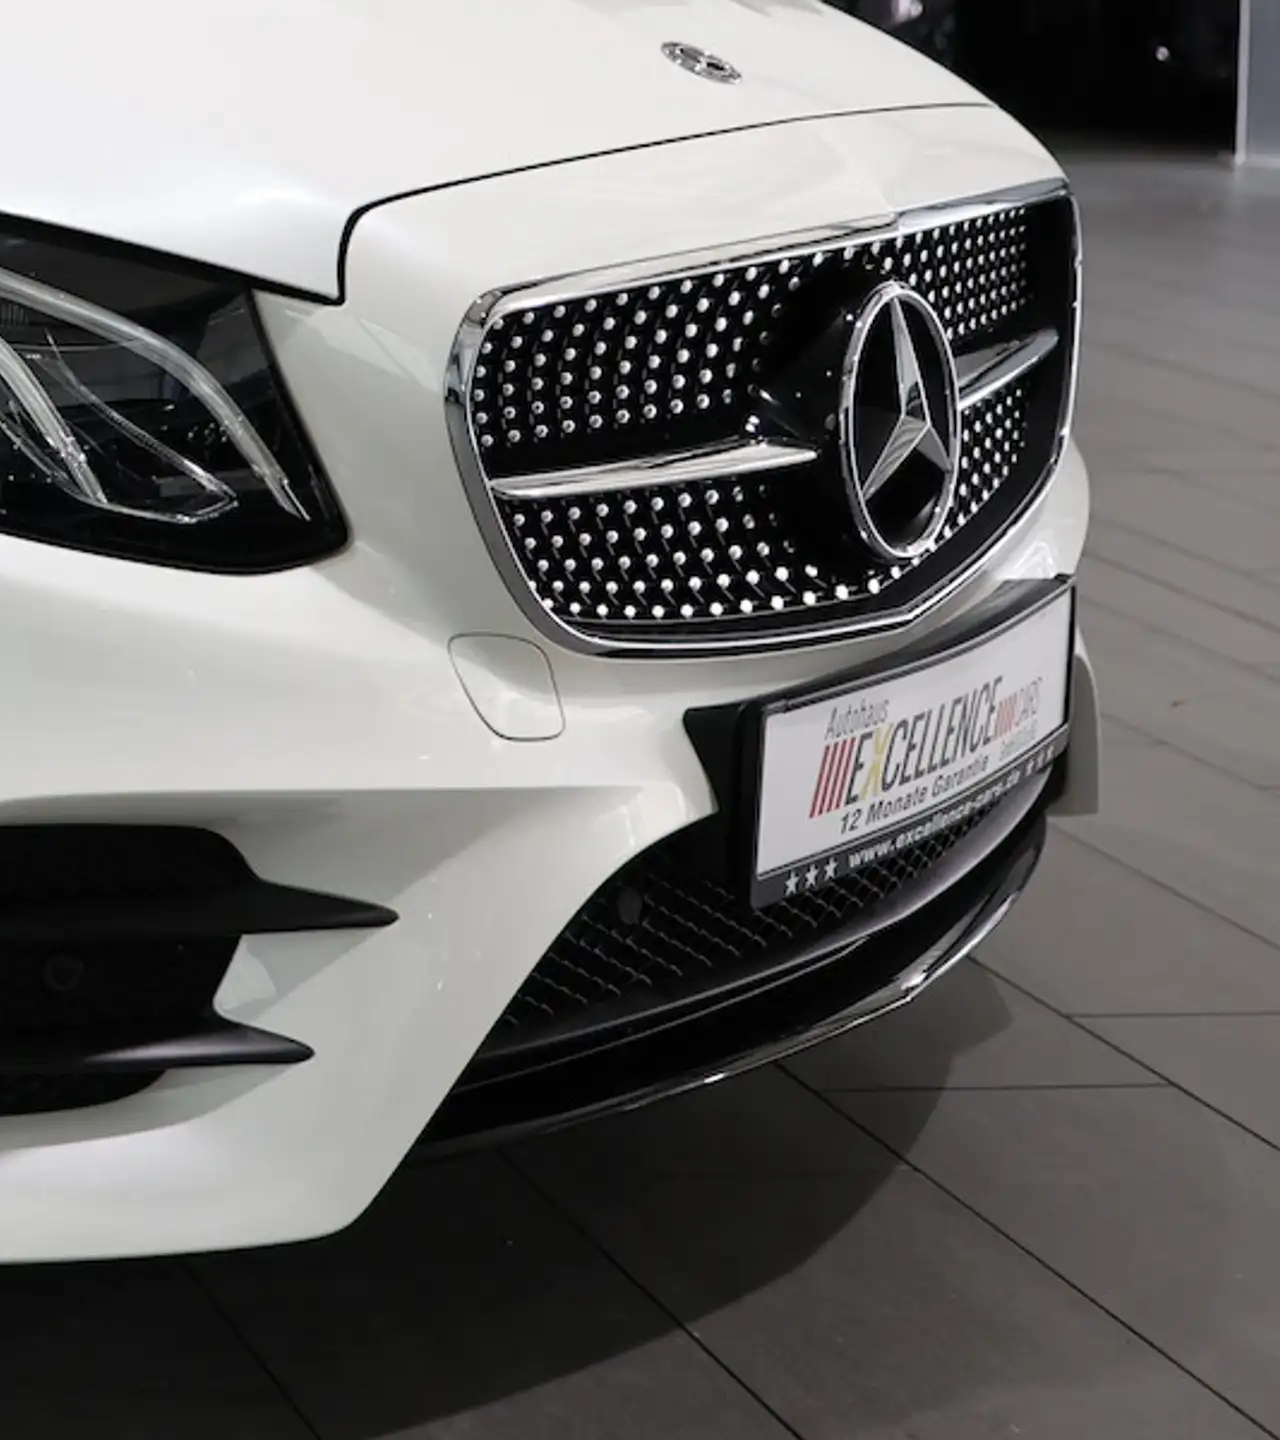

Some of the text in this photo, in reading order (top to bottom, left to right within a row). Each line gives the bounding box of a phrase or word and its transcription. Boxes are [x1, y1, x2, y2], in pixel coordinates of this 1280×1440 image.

[824, 698, 889, 740] Autohaus
[843, 676, 1003, 807] EXCELLENCE
[841, 808, 863, 834] 12
[866, 784, 928, 821] Monate
